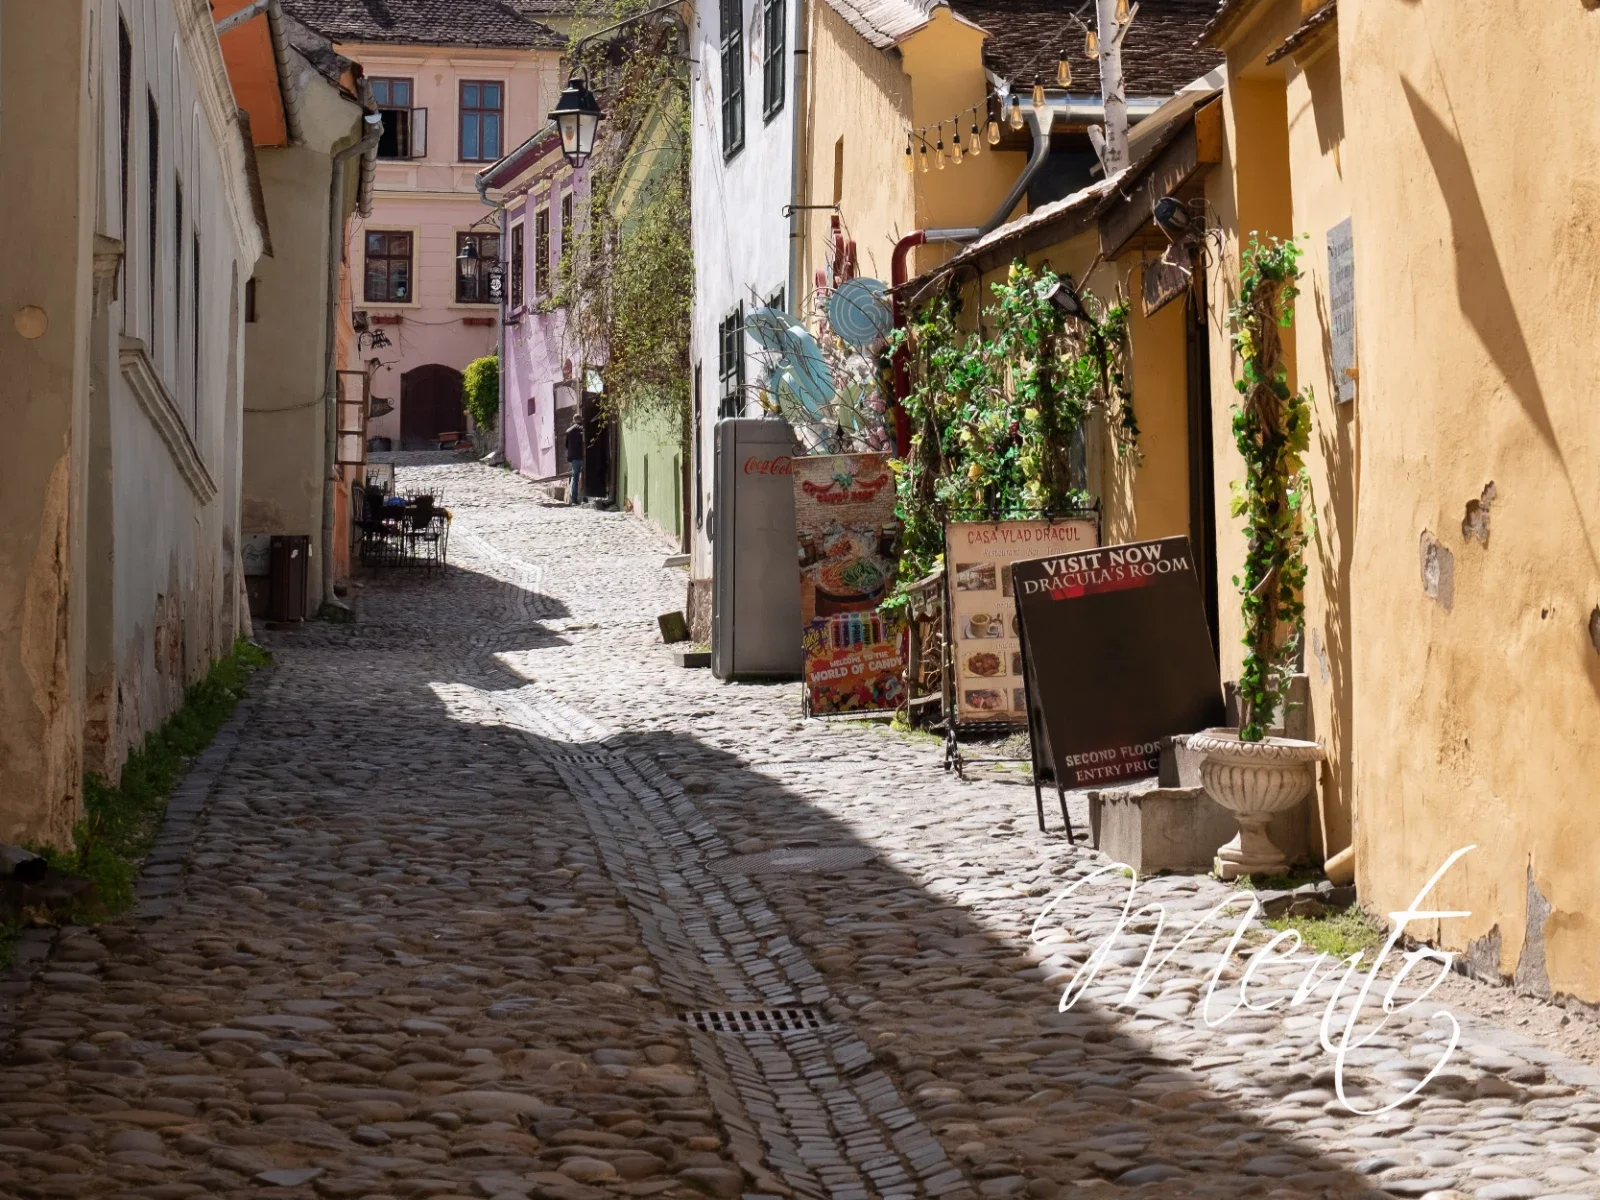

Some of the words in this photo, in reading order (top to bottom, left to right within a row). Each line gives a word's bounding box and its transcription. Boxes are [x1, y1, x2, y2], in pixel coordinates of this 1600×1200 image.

[967, 529, 998, 544] CASA
[1001, 529, 1032, 543] VLAD
[1035, 527, 1081, 542] DRACUL
[1042, 553, 1101, 576] VISIT
[1109, 544, 1162, 567] NOW
[1023, 566, 1125, 595] DRACULA'S
[1129, 557, 1189, 578] ROOM
[810, 666, 848, 682] WORLD
[851, 663, 865, 675] OF
[868, 656, 903, 672] CANDY
[829, 656, 861, 668] WELCOME
[863, 653, 873, 661] TO
[875, 650, 889, 659] THE
[1065, 749, 1117, 767] SECOND
[1075, 765, 1121, 781] ENTRY
[1125, 758, 1160, 774] PRIC
